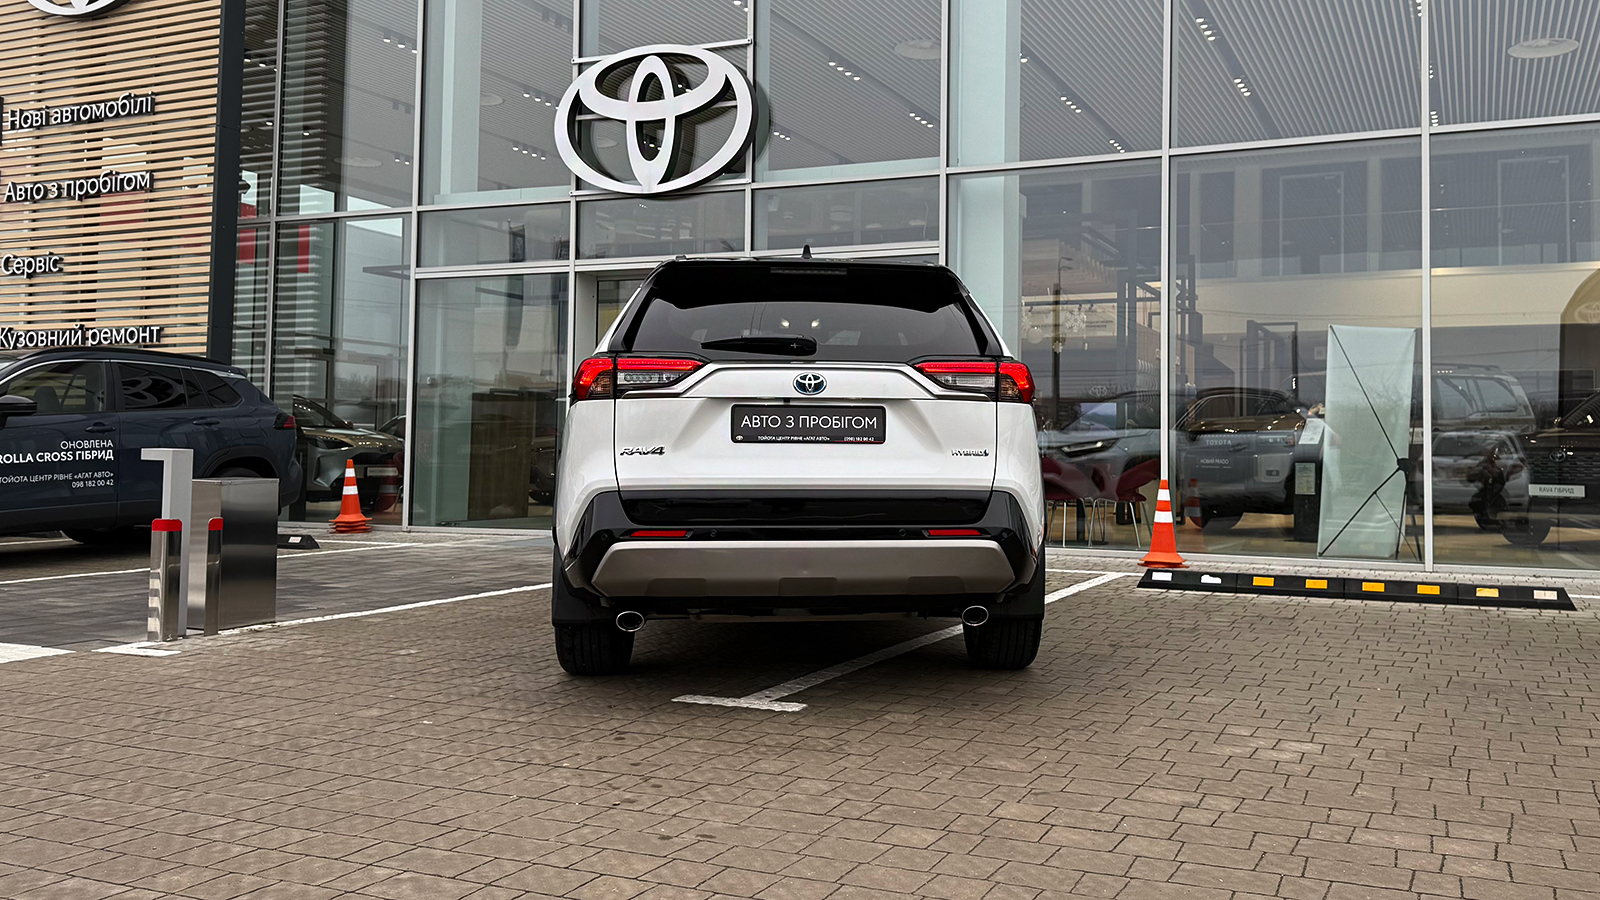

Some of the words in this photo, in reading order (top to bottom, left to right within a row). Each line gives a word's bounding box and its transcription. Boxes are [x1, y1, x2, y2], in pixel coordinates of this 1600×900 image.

[8, 105, 48, 129] Нові
[51, 91, 153, 124] автомобілі
[4, 181, 45, 202] Авто
[49, 182, 59, 199] з
[64, 170, 151, 200] пробігом
[1, 252, 60, 278] Сервіс
[0, 324, 82, 349] Кузовний
[88, 325, 160, 347] ремонт
[740, 415, 781, 428] АВТО
[785, 415, 795, 428] З
[799, 415, 877, 429] ПРОБІГОМ
[60, 439, 114, 450] ОНОВЛЕНА
[619, 446, 665, 456] RAV4
[36, 451, 74, 463] CROSS
[75, 449, 114, 461] ГІБРИД
[951, 448, 984, 457] HYBRID
[29, 474, 53, 483] ЦЕНТР
[53, 473, 73, 482] РІВНЕ
[74, 472, 92, 480] «АГАТ
[93, 470, 114, 479] АВТО»
[71, 480, 84, 488] 098
[96, 479, 106, 487] 00
[106, 478, 115, 486] 42
